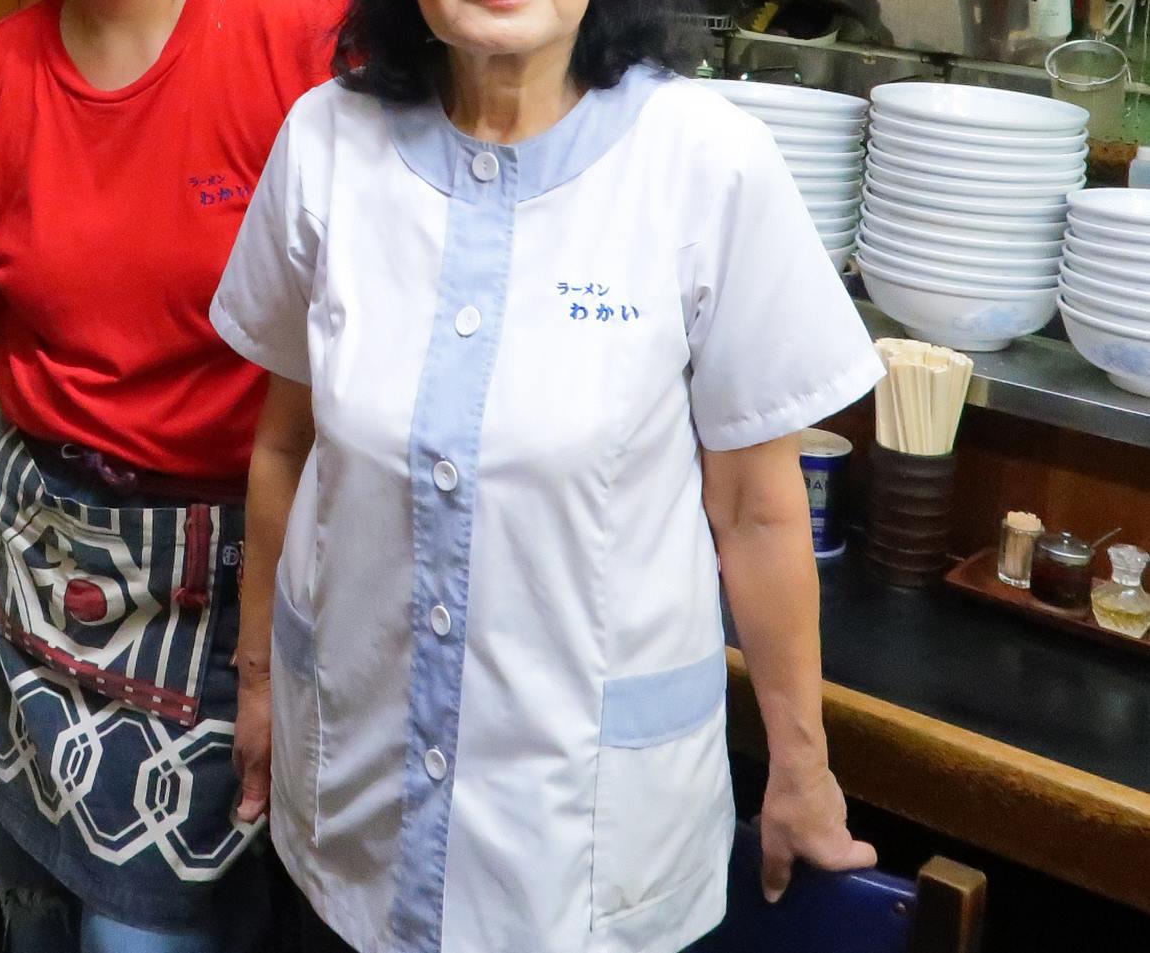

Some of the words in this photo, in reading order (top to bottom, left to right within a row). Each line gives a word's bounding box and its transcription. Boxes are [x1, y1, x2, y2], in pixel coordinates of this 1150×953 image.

[556, 282, 610, 296] ラーメン
[570, 302, 640, 322] わかい
